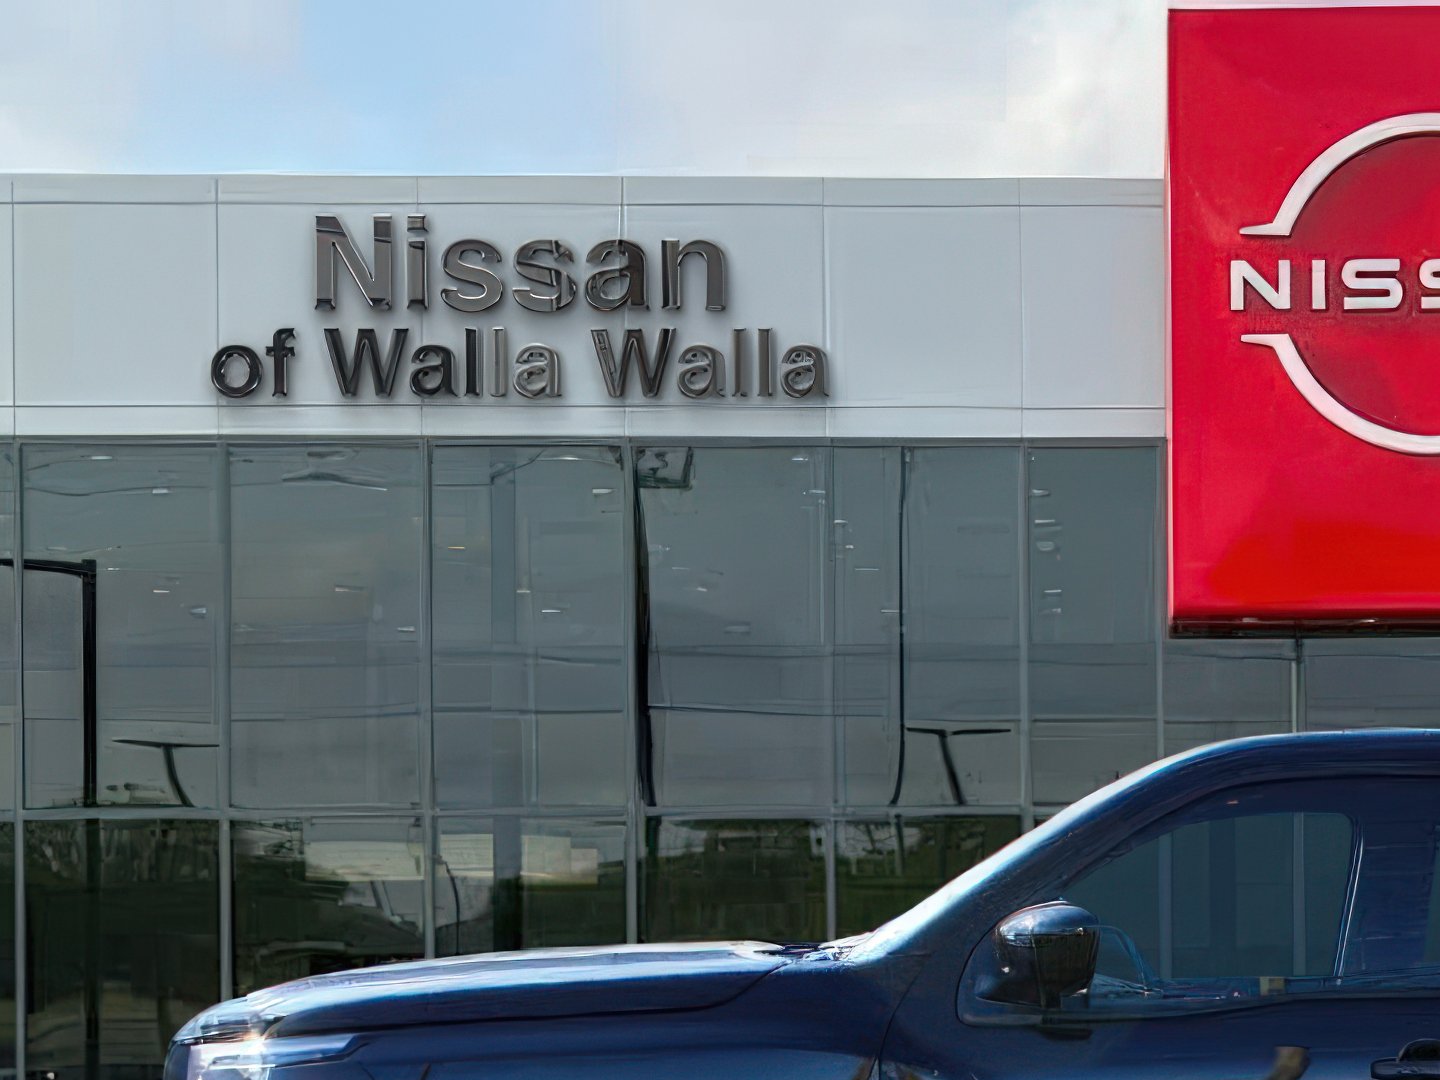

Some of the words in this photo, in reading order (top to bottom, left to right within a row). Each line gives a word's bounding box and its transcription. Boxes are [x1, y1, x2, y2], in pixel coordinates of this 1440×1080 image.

[314, 214, 727, 312] Nissan
[211, 327, 296, 398] of
[324, 327, 564, 398] Walla
[590, 327, 831, 398] Walla
